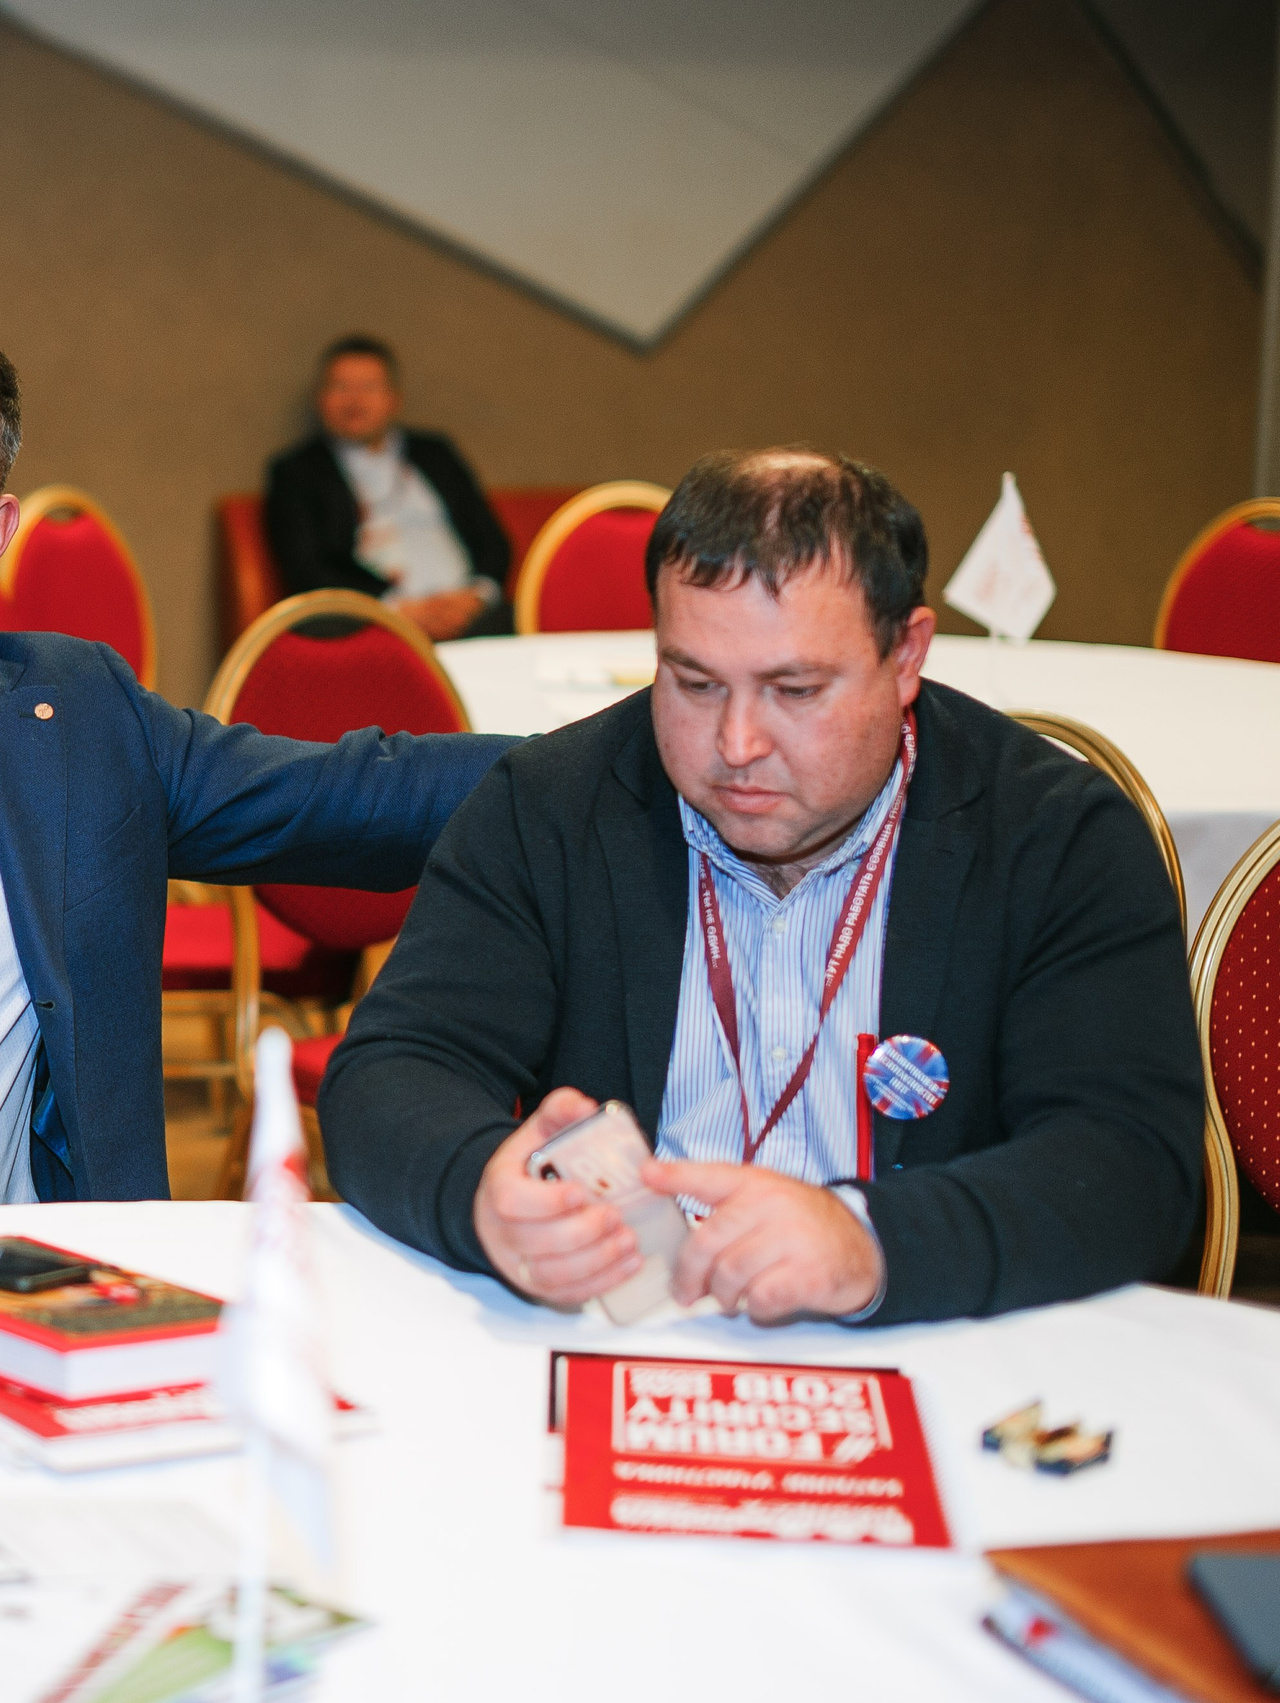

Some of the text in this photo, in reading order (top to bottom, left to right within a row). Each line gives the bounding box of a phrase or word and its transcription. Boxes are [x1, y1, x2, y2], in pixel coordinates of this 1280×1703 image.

[705, 908, 716, 924] НЕ
[833, 927, 854, 959] НАДО
[846, 873, 874, 927] РАБОТАТЬ
[627, 1397, 874, 1434] SECURITY
[626, 1421, 824, 1461] FORUM
